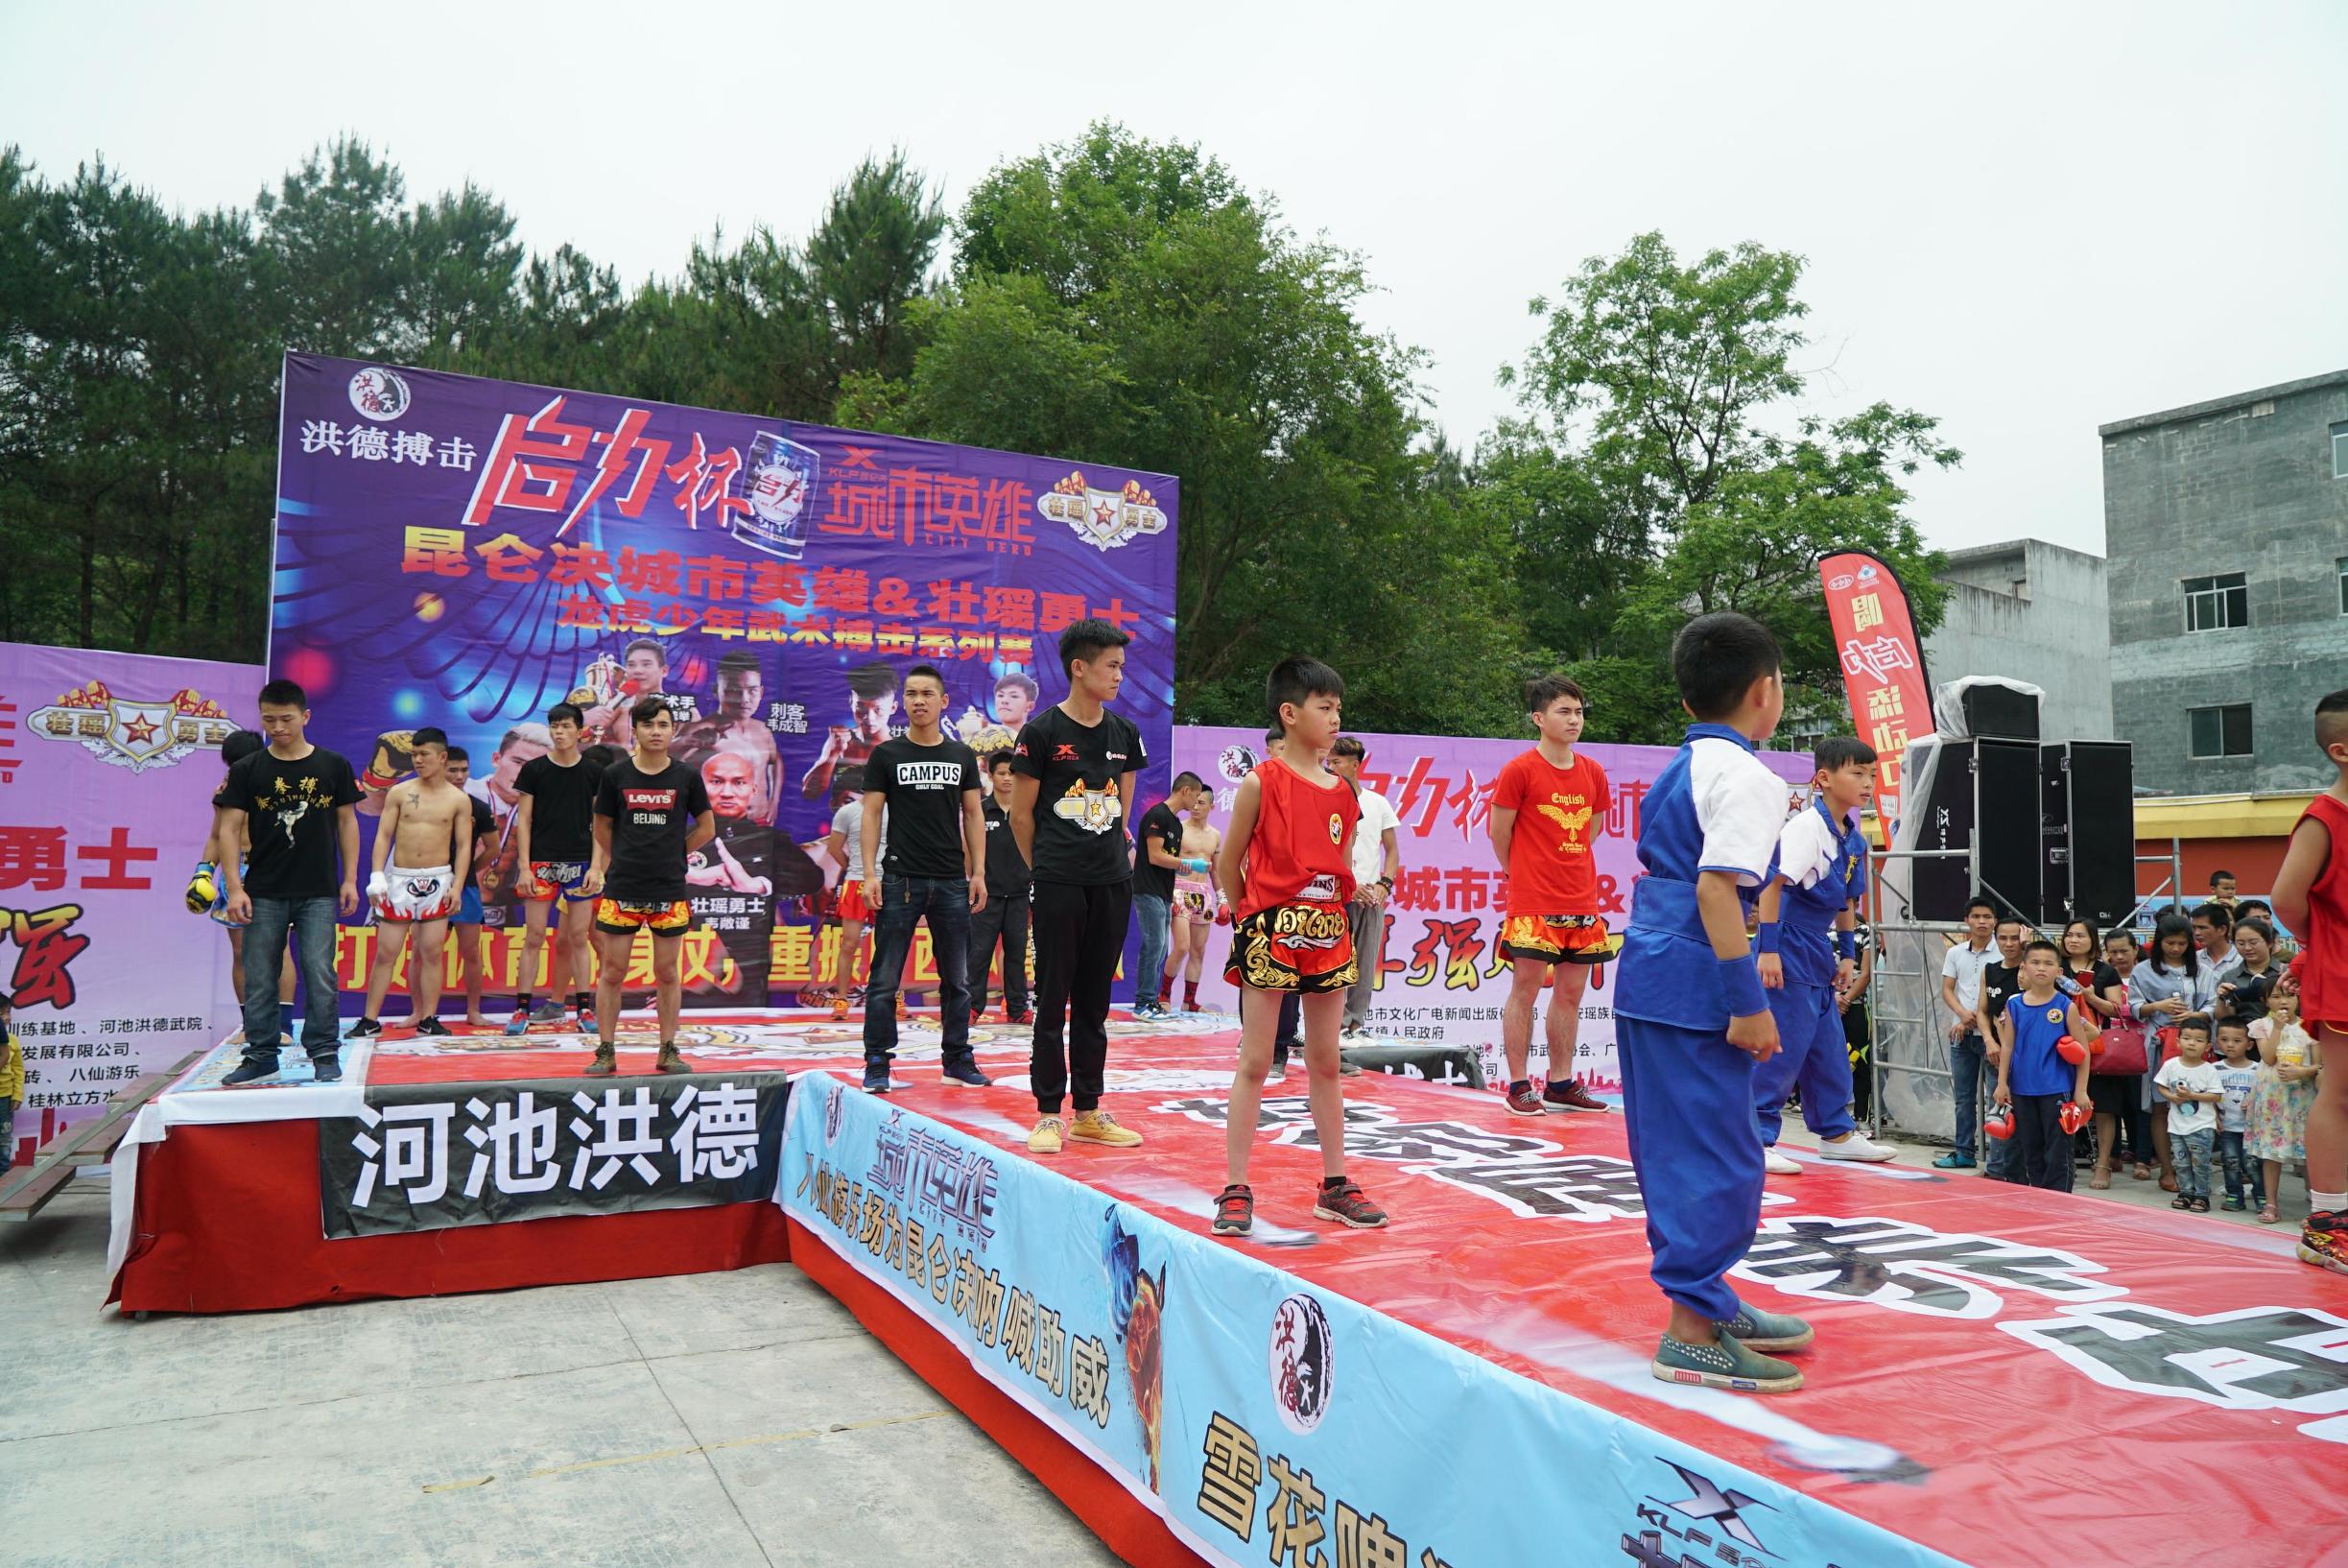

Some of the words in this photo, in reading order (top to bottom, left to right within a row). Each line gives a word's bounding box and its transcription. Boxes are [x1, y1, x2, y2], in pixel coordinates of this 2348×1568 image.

[299, 419, 478, 471] 洪德搏击
[818, 465, 1036, 546] 城市英雄
[925, 534, 968, 549] CITY
[987, 541, 1032, 557] HERO
[771, 702, 805, 720] 刺客
[899, 764, 960, 782] CAMPUS
[633, 813, 667, 825] BEIJING
[1551, 793, 1585, 806] English
[351, 1081, 760, 1209] 河池洪德
[867, 1128, 999, 1239] 城市英雄
[796, 1152, 1111, 1430] 八仙游乐场为昆仑决呐喊助威
[1198, 1411, 1458, 1568] 雪花啤
